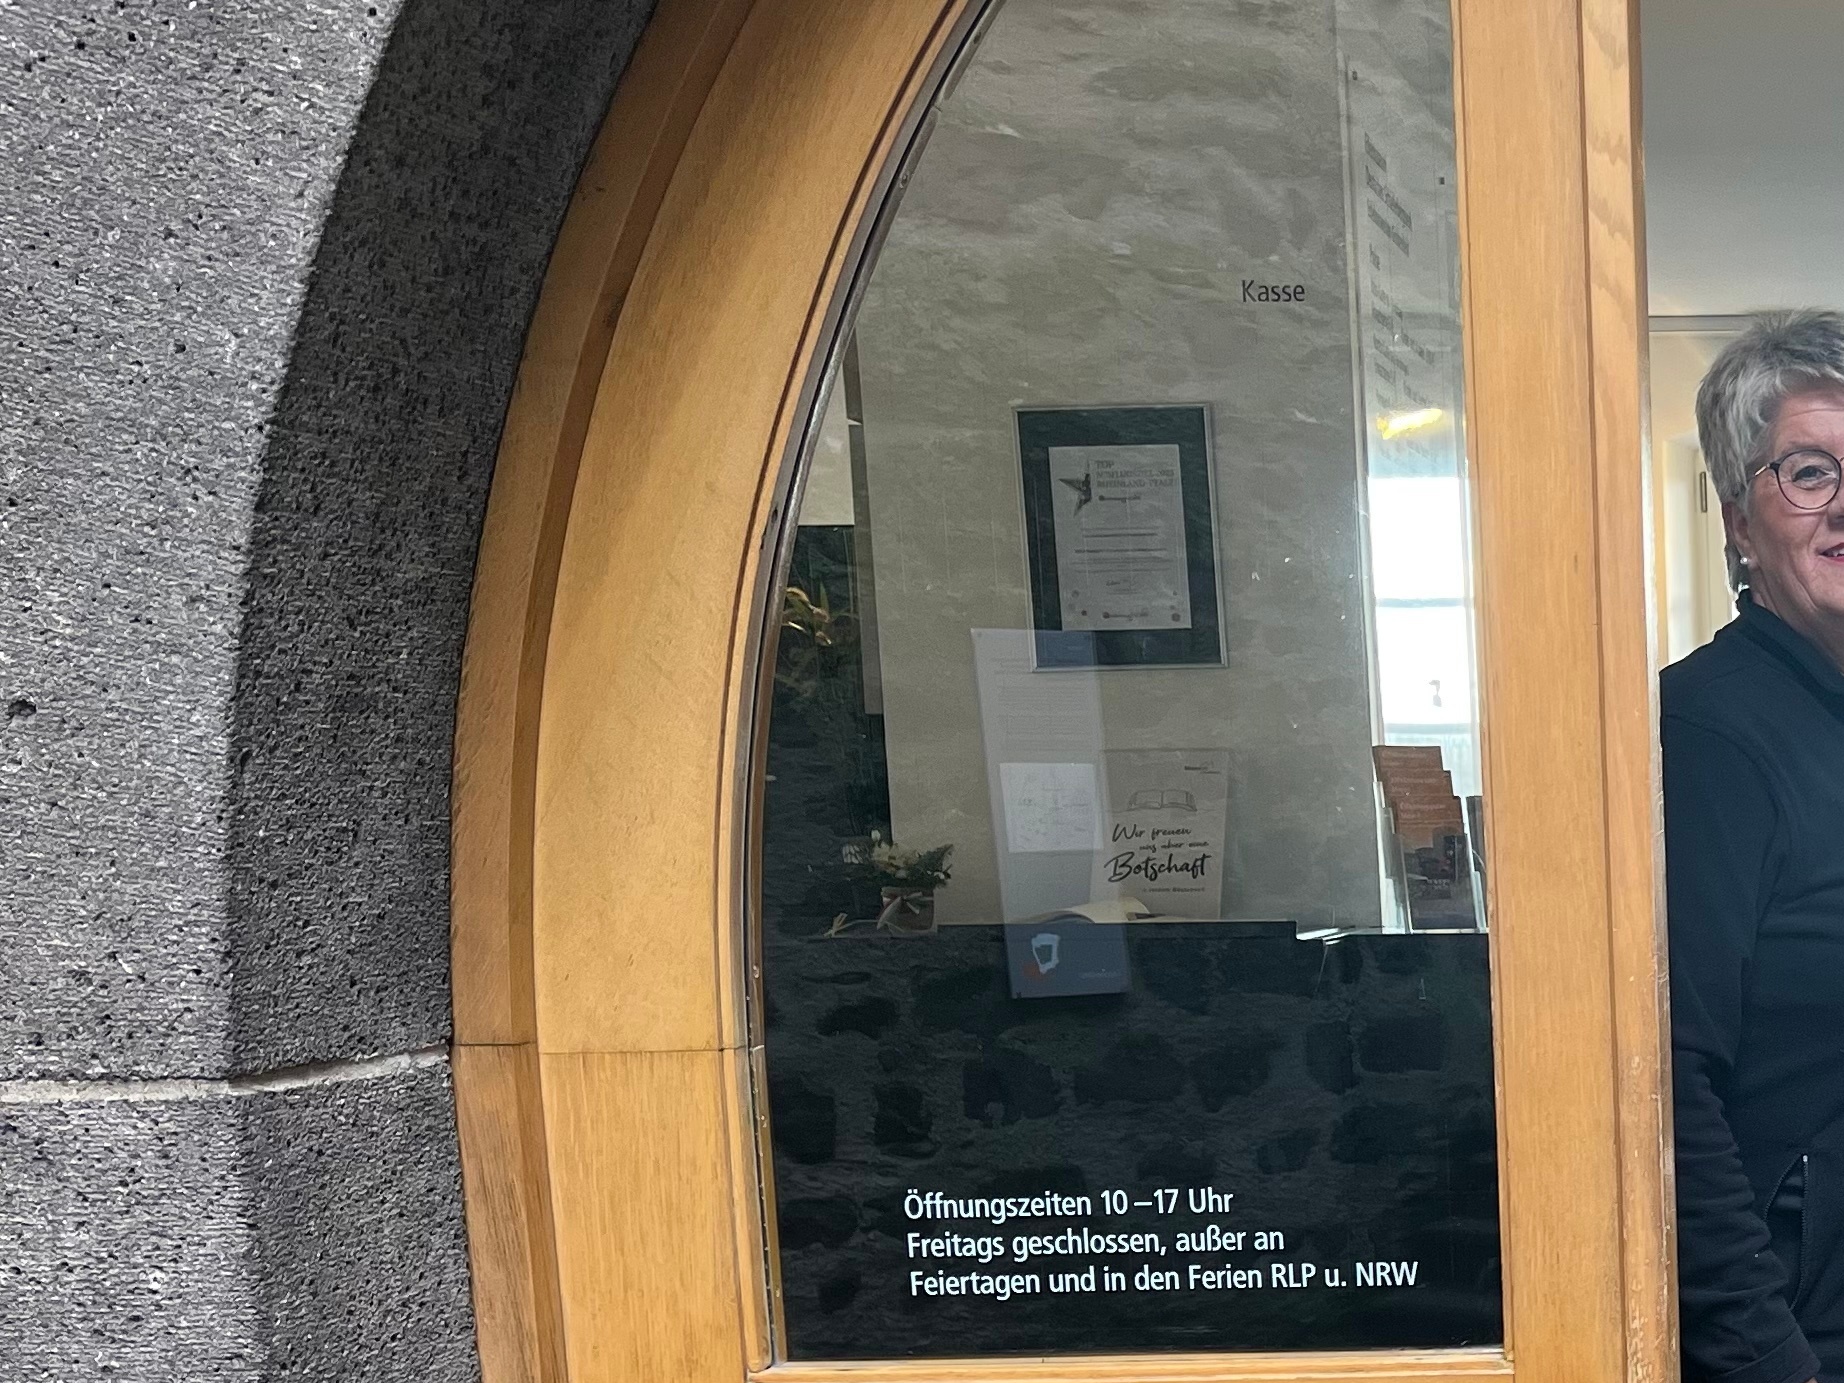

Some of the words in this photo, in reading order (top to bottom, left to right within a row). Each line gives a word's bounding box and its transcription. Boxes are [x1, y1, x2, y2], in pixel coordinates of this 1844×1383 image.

[1242, 279, 1306, 303] Kasse
[1112, 823, 1145, 842] Wir
[1151, 828, 1192, 841] freuen
[1103, 851, 1212, 883] Botschaft
[904, 1188, 1092, 1224] Öffnungszeiten
[1099, 1189, 1129, 1215] 10
[1188, 1186, 1234, 1214] Uhr
[907, 1230, 1005, 1263] Freitags
[1012, 1227, 1167, 1263] geschlossen,
[1175, 1224, 1247, 1252] außer
[1253, 1231, 1285, 1251] an
[910, 1269, 1041, 1301] Feiertagen
[1048, 1265, 1097, 1293] und
[1103, 1265, 1127, 1292] in
[1134, 1264, 1181, 1291] den
[1188, 1263, 1263, 1290] Ferien
[1270, 1262, 1317, 1288] RLP
[1324, 1268, 1347, 1288] u.
[1355, 1261, 1419, 1287] NRW
